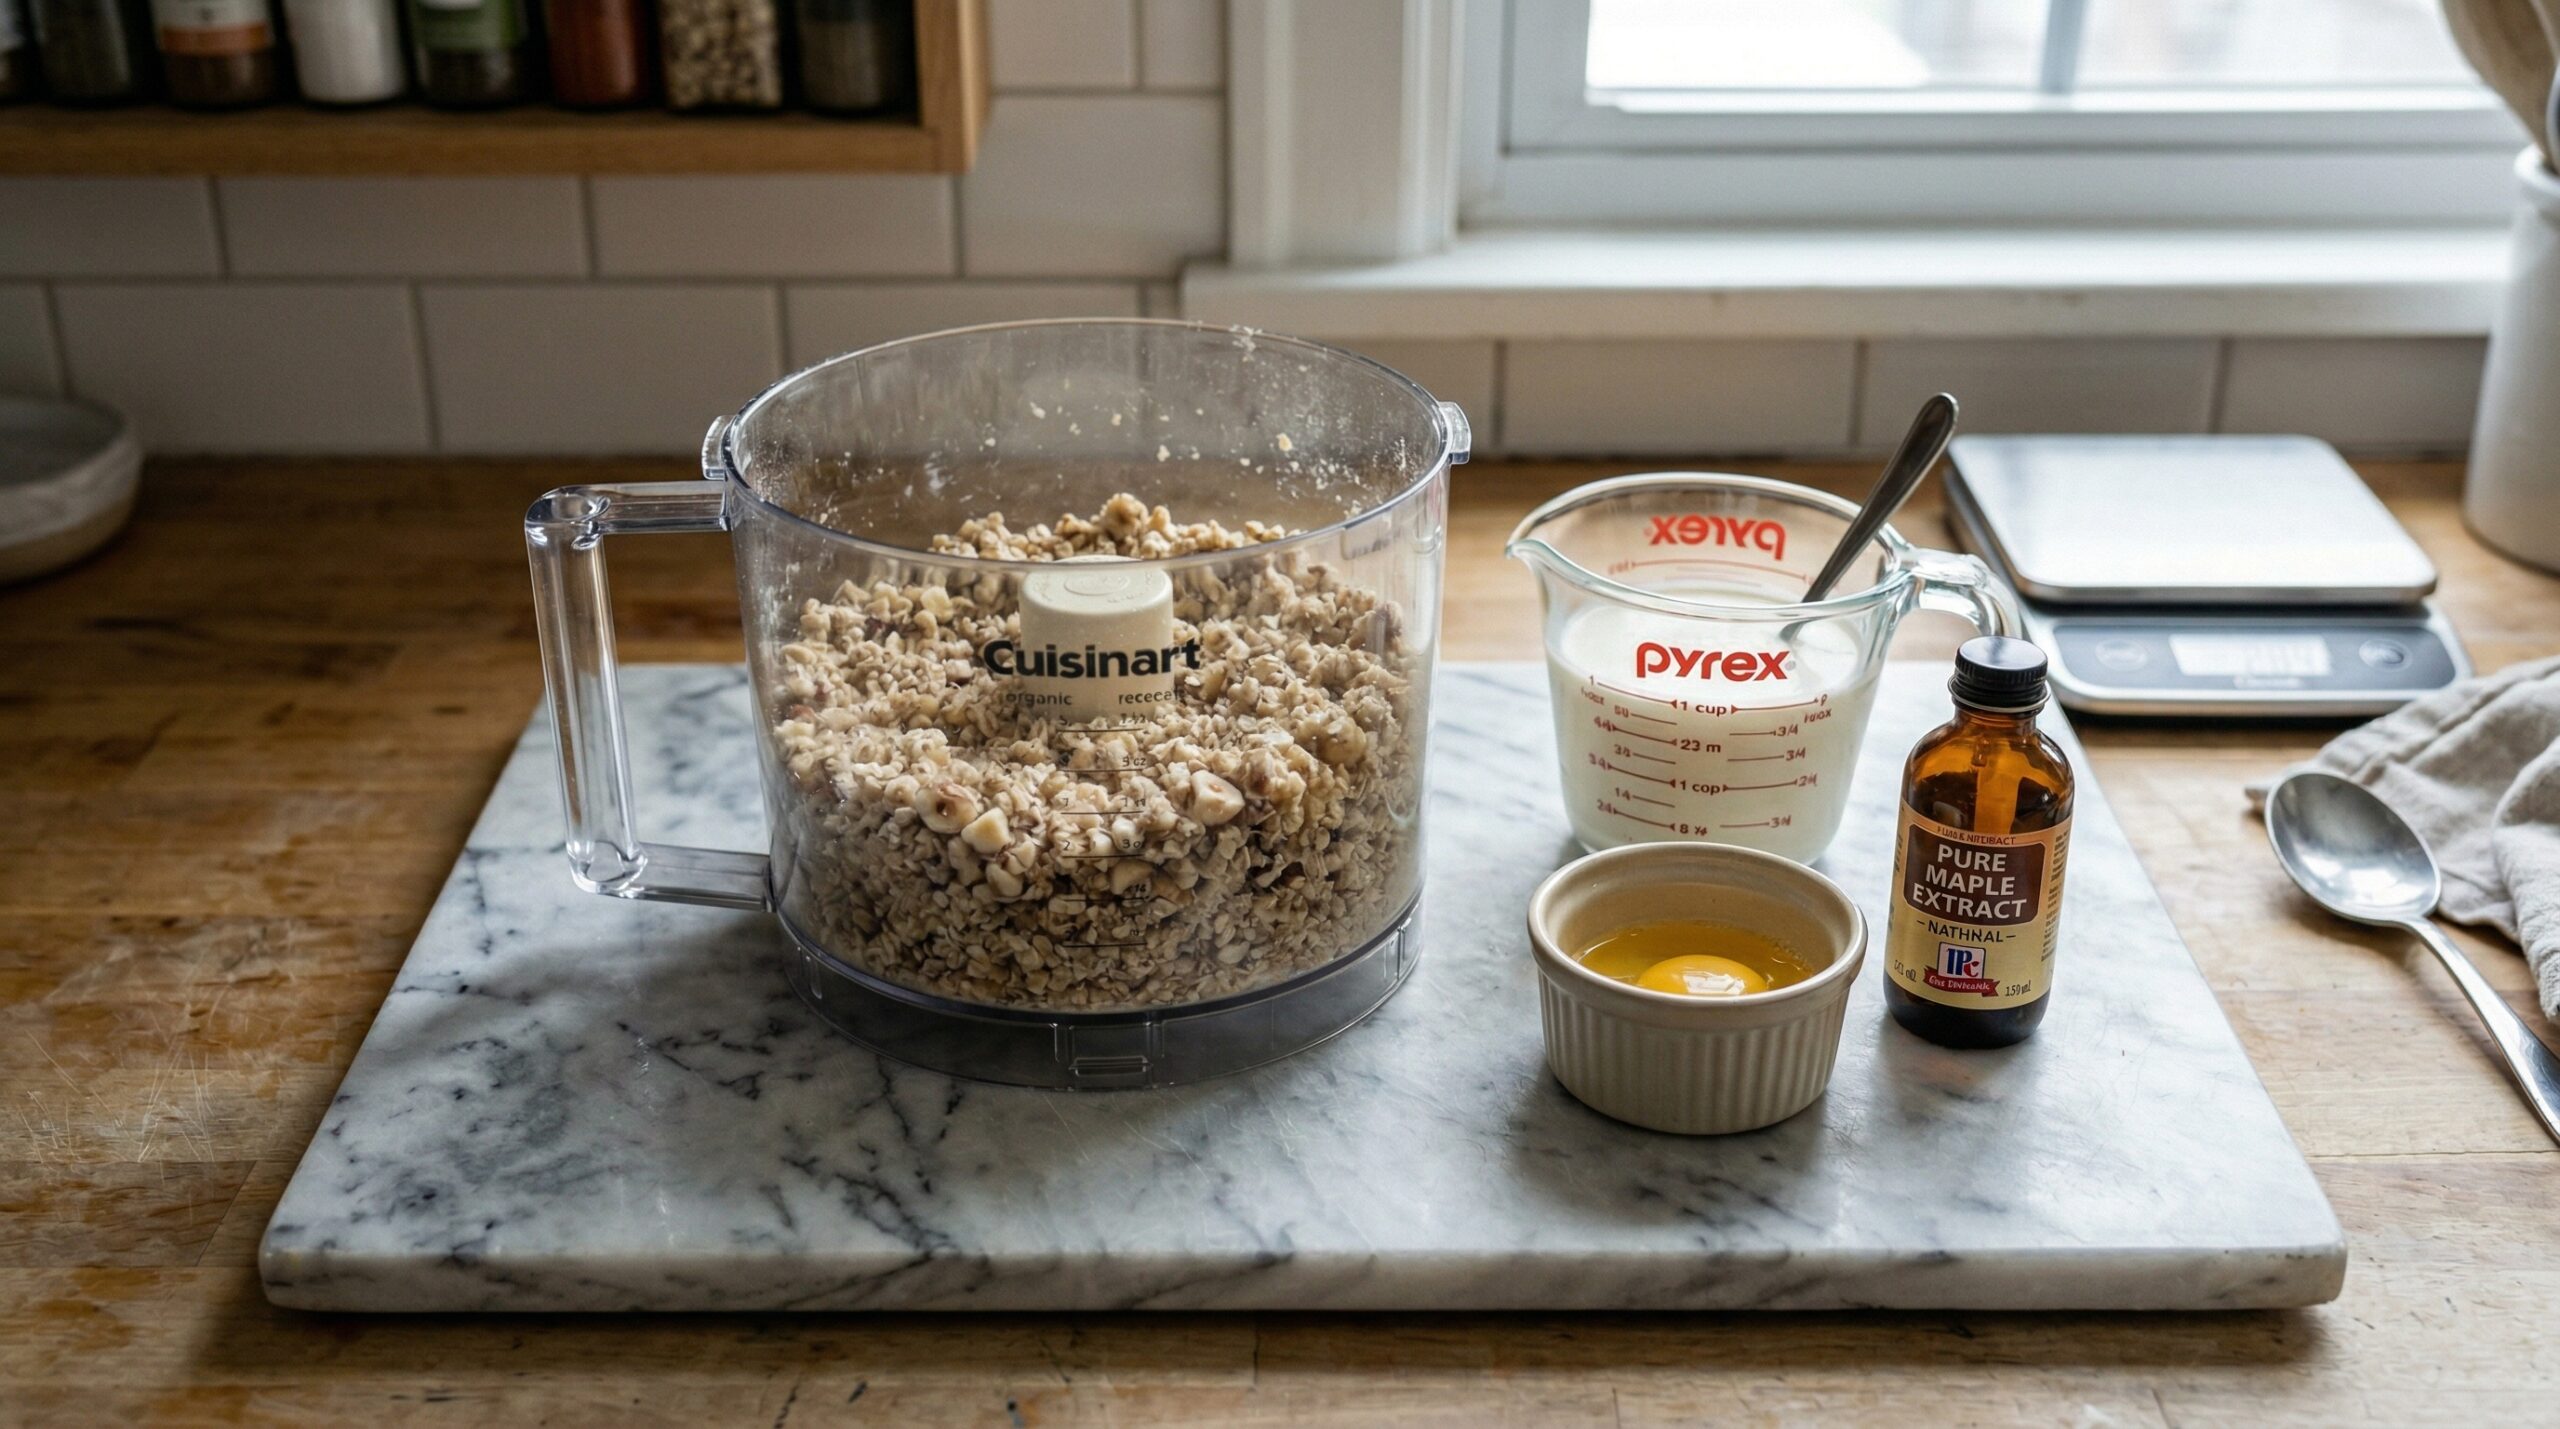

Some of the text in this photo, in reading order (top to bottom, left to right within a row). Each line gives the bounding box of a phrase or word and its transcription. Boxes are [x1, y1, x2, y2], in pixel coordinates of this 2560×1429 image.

[984, 637, 1200, 678] Cuisinart
[1636, 642, 1790, 682] pyrex
[1005, 691, 1073, 706] organic
[1680, 701, 1727, 717] 1 cup
[1681, 739, 1721, 753] 23 m
[1680, 780, 1721, 796] 1 cop
[1679, 824, 1689, 834] 8
[1937, 844, 2007, 872] PURE
[1925, 864, 2016, 896] MAPLE
[1912, 883, 2027, 919] EXTRACT
